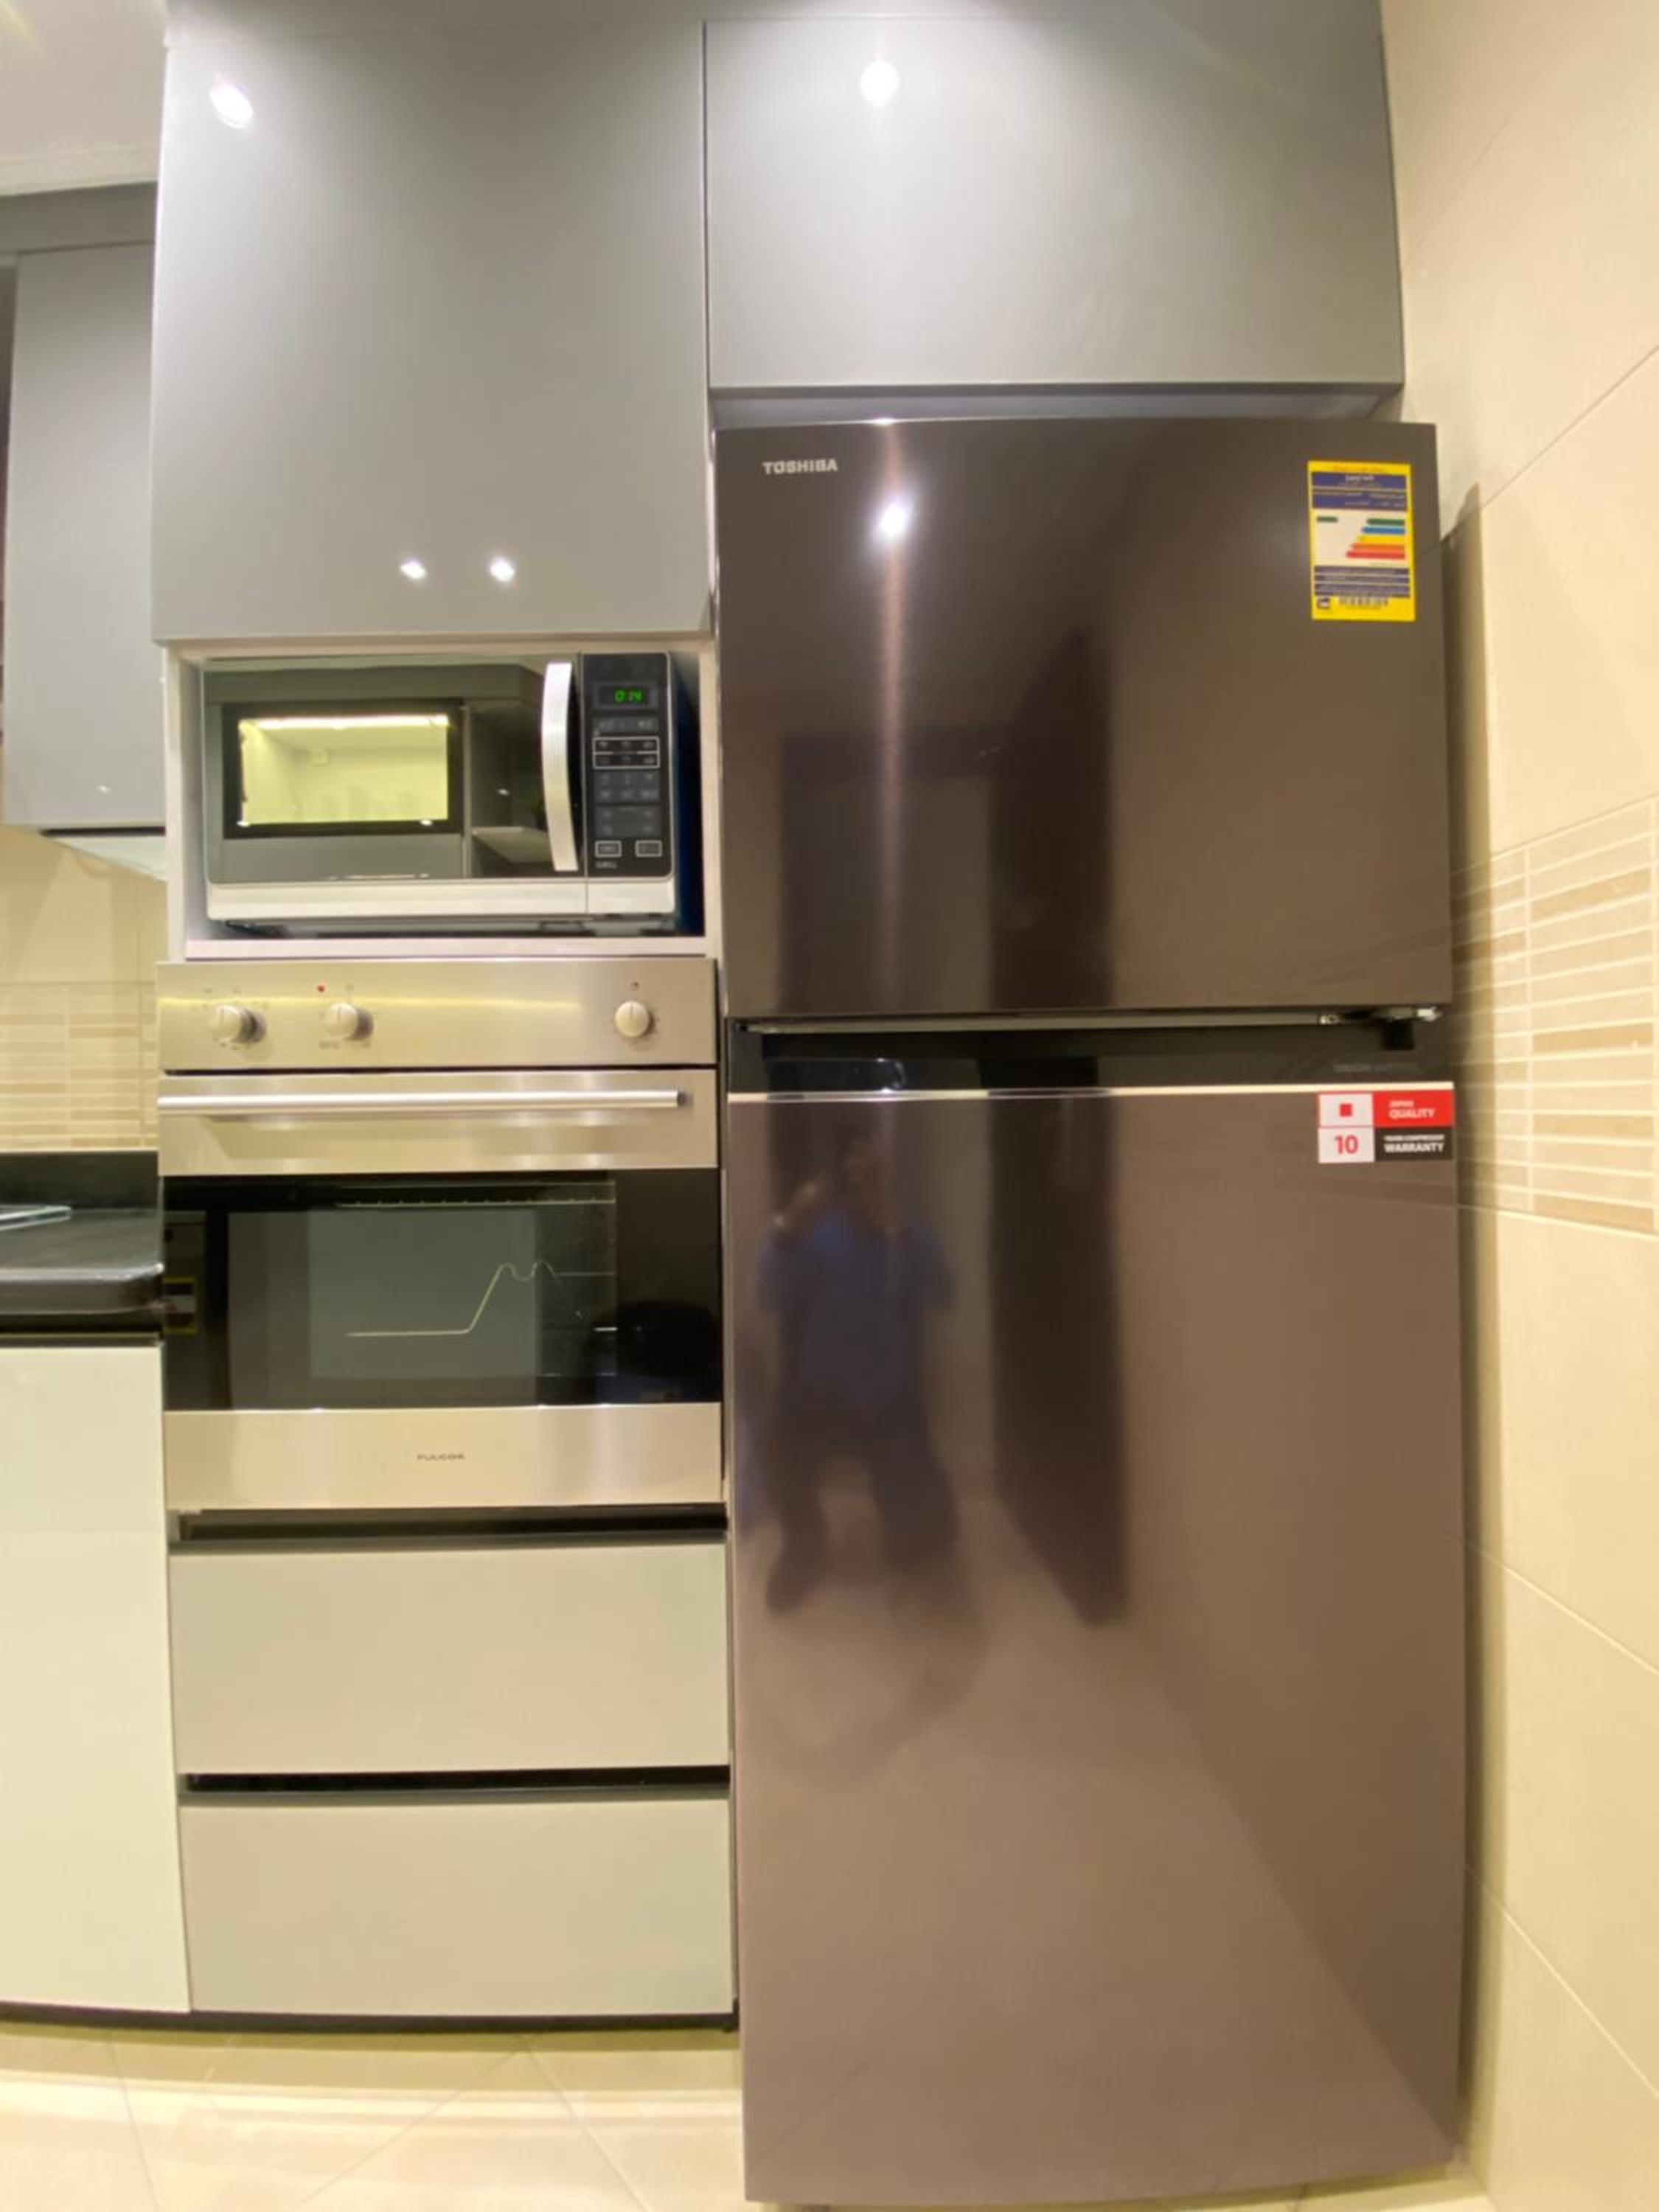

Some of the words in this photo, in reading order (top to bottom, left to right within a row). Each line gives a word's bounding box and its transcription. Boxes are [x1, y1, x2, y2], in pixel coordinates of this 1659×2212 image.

[762, 459, 838, 474] TOSHIBA
[1389, 1107, 1436, 1120] QUALITY
[1335, 1134, 1358, 1154] 10
[1383, 1142, 1444, 1153] WARRANTY
